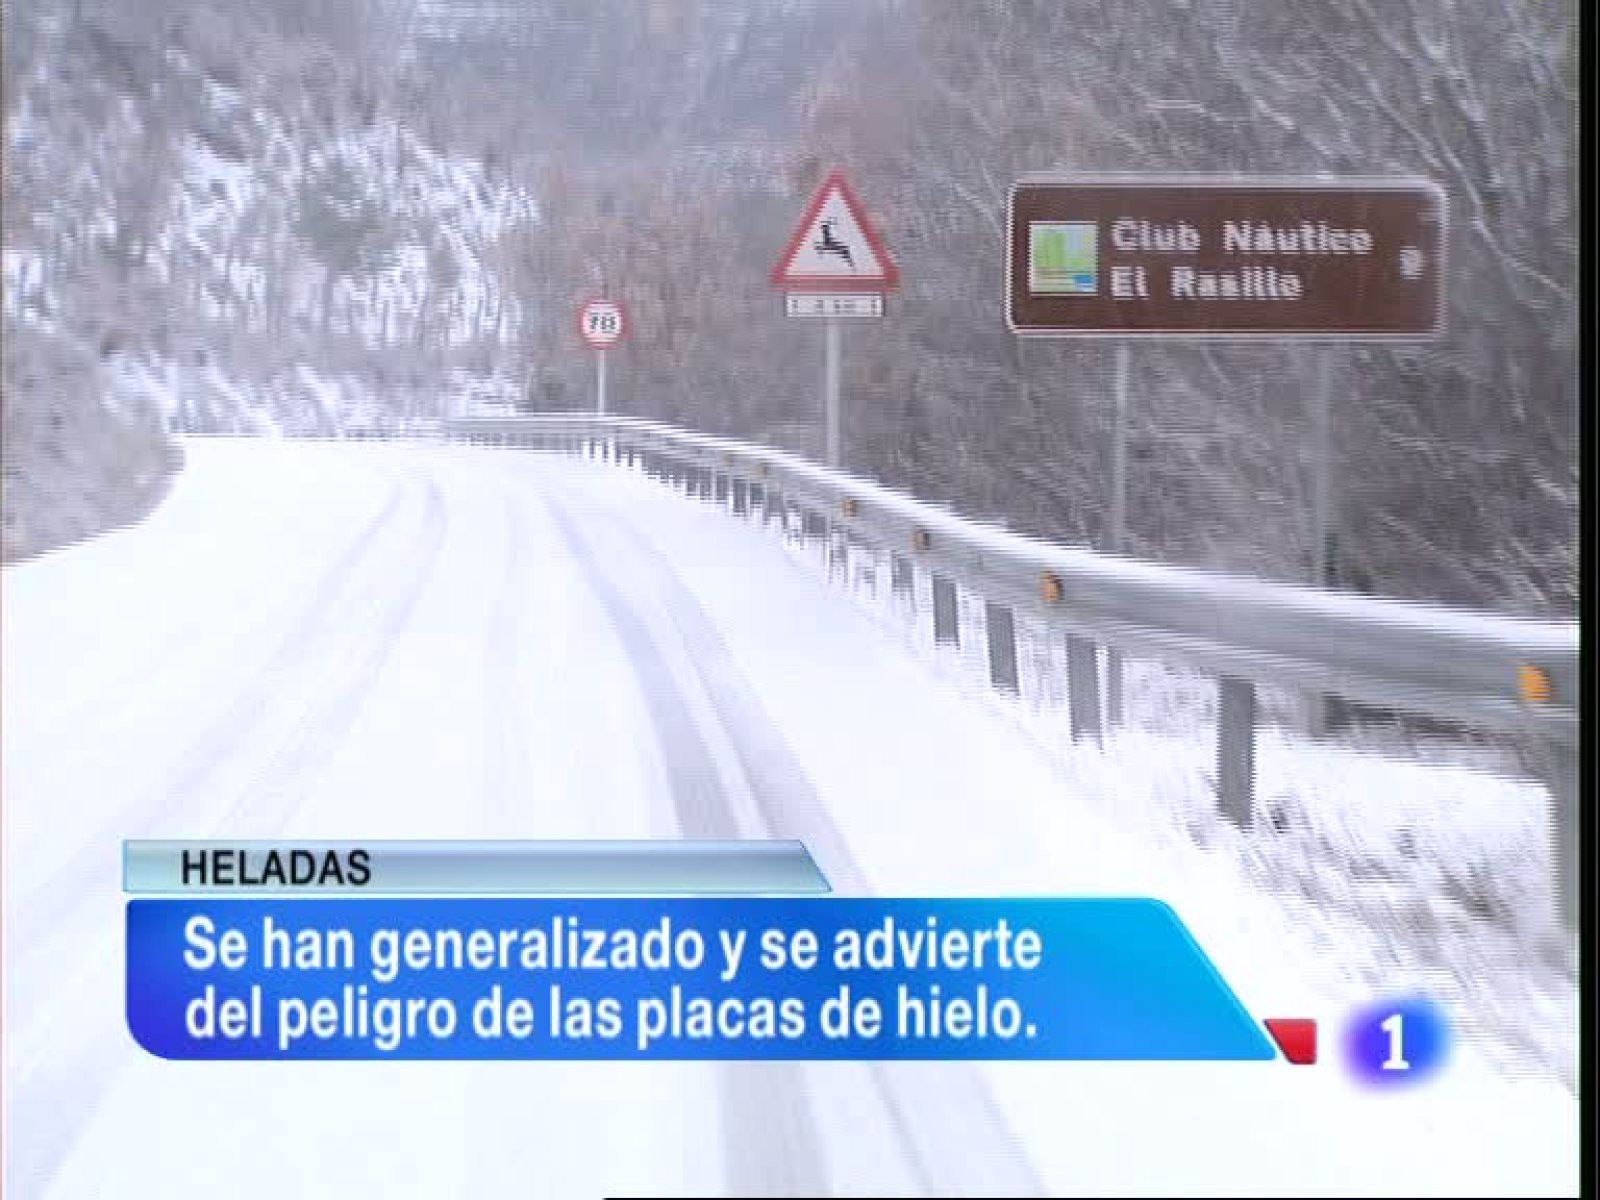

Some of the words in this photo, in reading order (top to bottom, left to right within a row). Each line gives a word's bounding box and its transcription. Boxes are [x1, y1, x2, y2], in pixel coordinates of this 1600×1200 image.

[1111, 217, 1201, 253] Club
[1110, 266, 1149, 299] El
[1171, 267, 1302, 300] Rasillo
